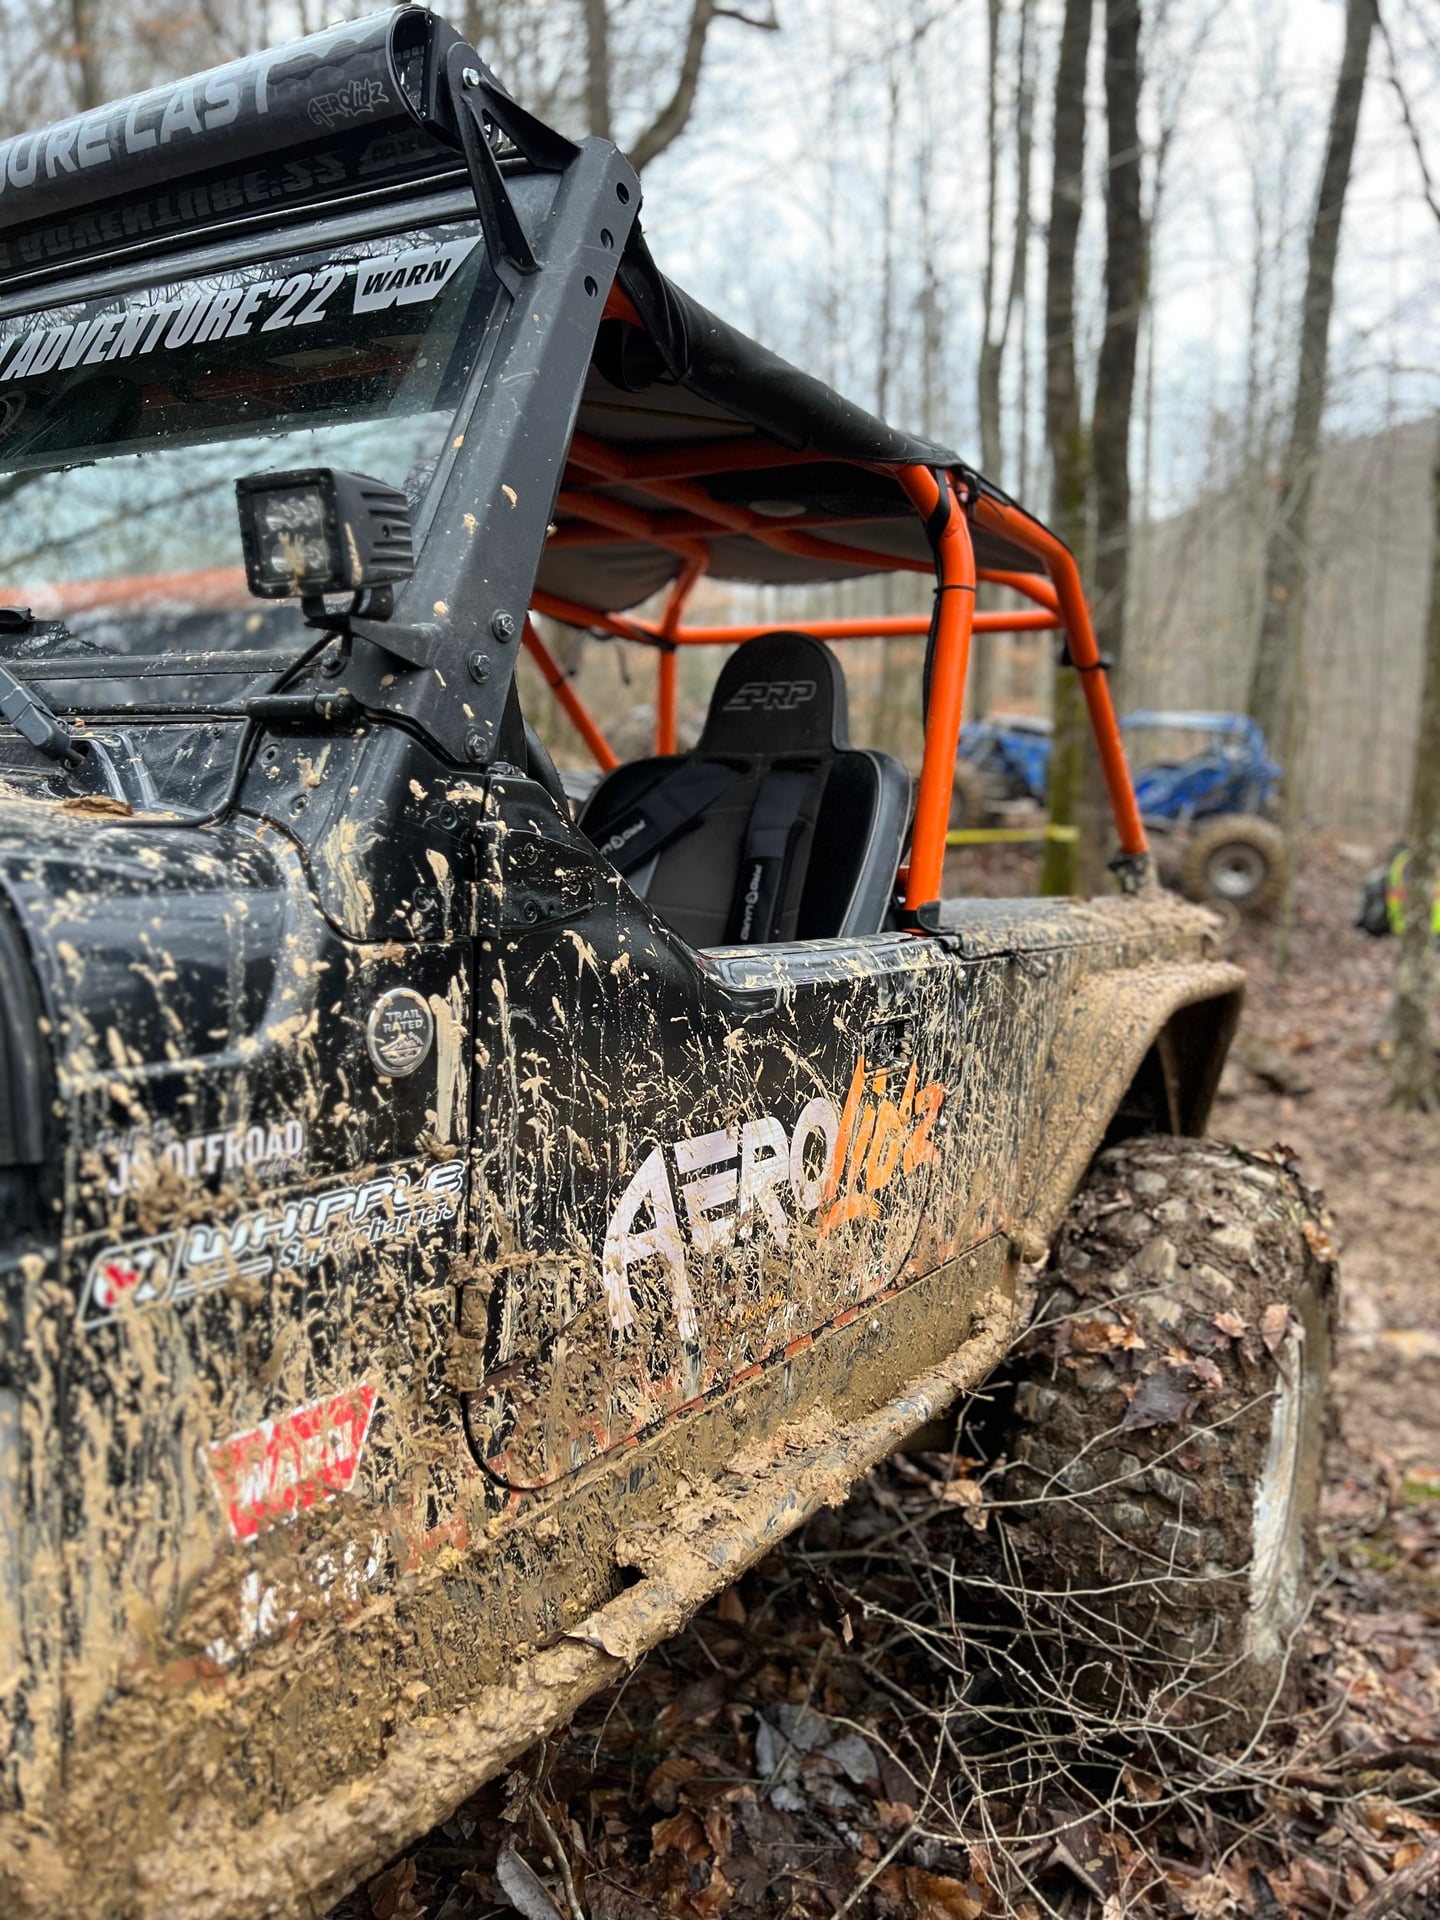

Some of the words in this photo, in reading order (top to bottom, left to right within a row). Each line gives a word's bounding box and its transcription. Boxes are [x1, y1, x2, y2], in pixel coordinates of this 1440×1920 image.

[125, 60, 272, 154] LAST
[361, 258, 452, 297] WARN
[0, 265, 347, 381] ADVENTURE'22
[722, 680, 817, 711] PRP
[385, 1008, 422, 1022] TRAIL
[164, 1119, 305, 1178] OFFROAD
[182, 1159, 466, 1268] WHIPPLE
